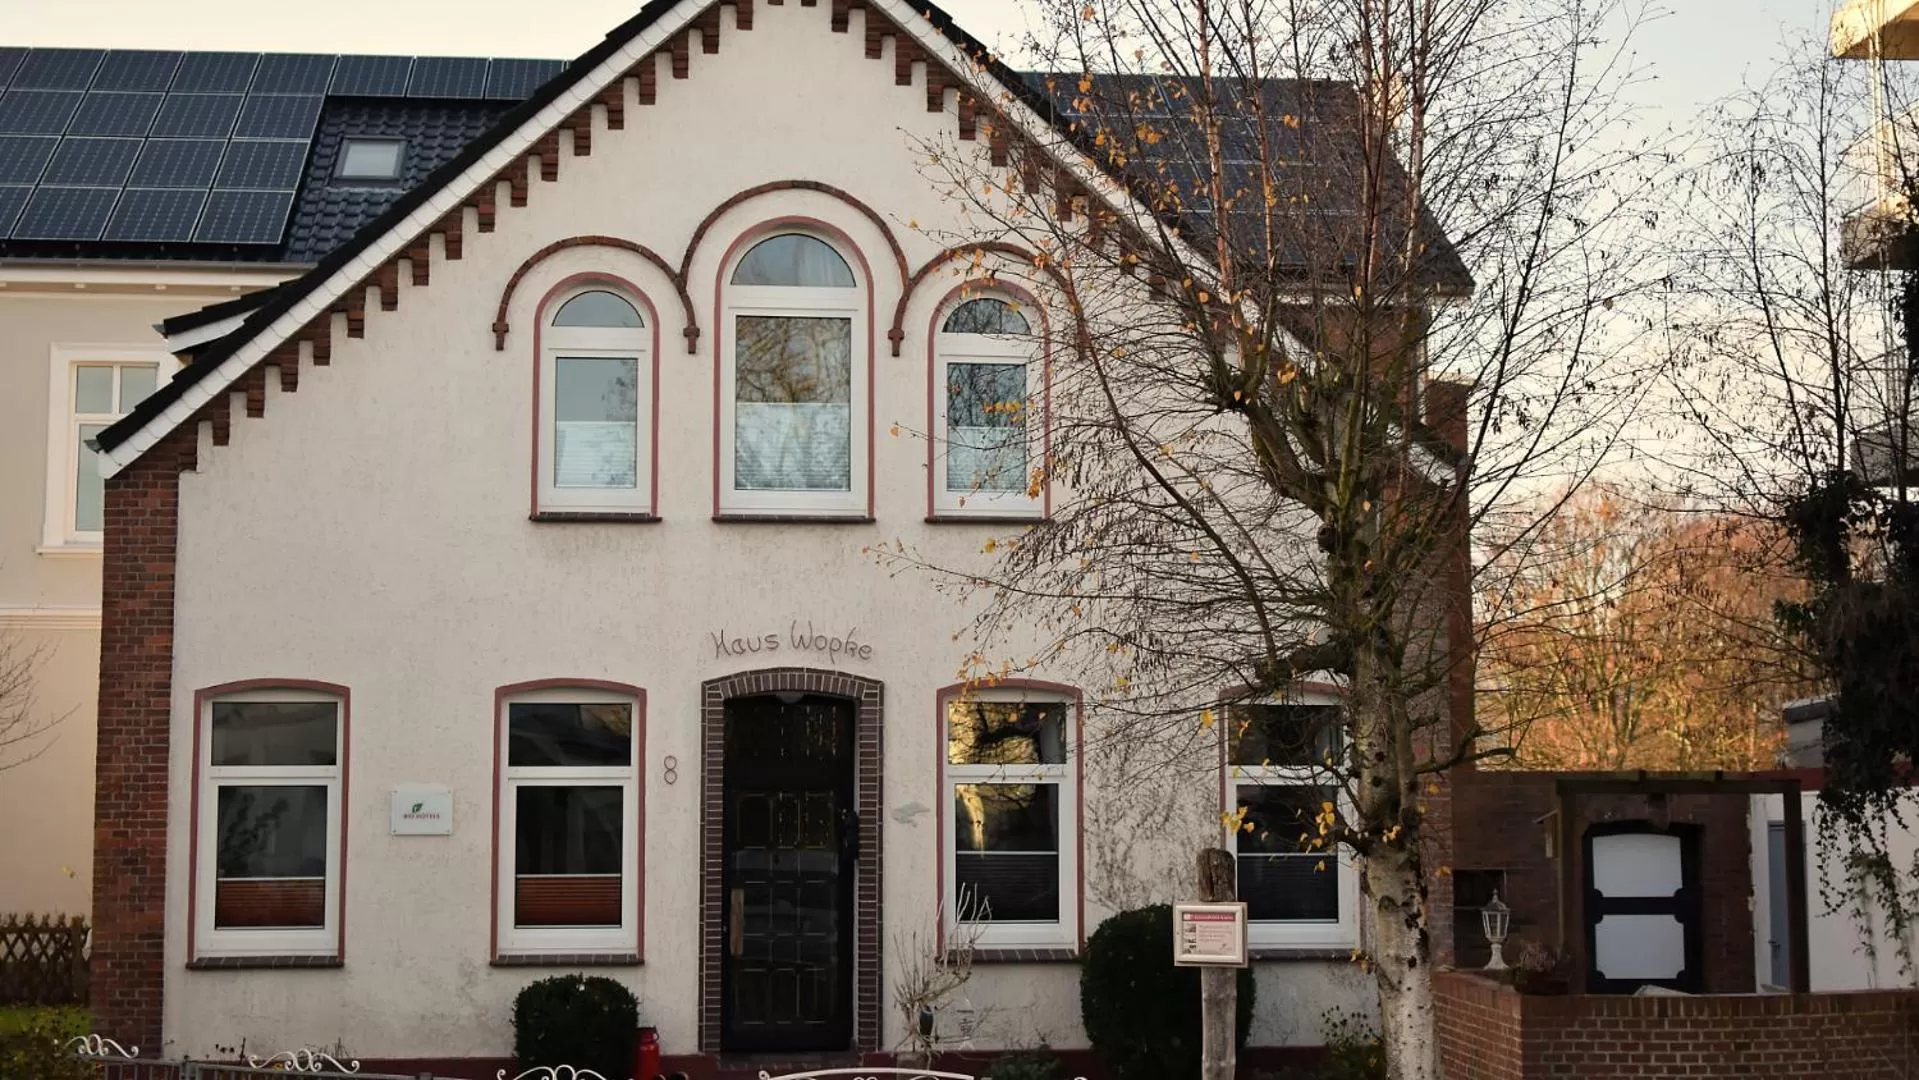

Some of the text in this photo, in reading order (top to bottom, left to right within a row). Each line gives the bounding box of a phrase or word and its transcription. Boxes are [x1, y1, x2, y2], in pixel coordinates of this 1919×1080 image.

[710, 620, 873, 664] Haus Wopke
[663, 755, 678, 785] 8
